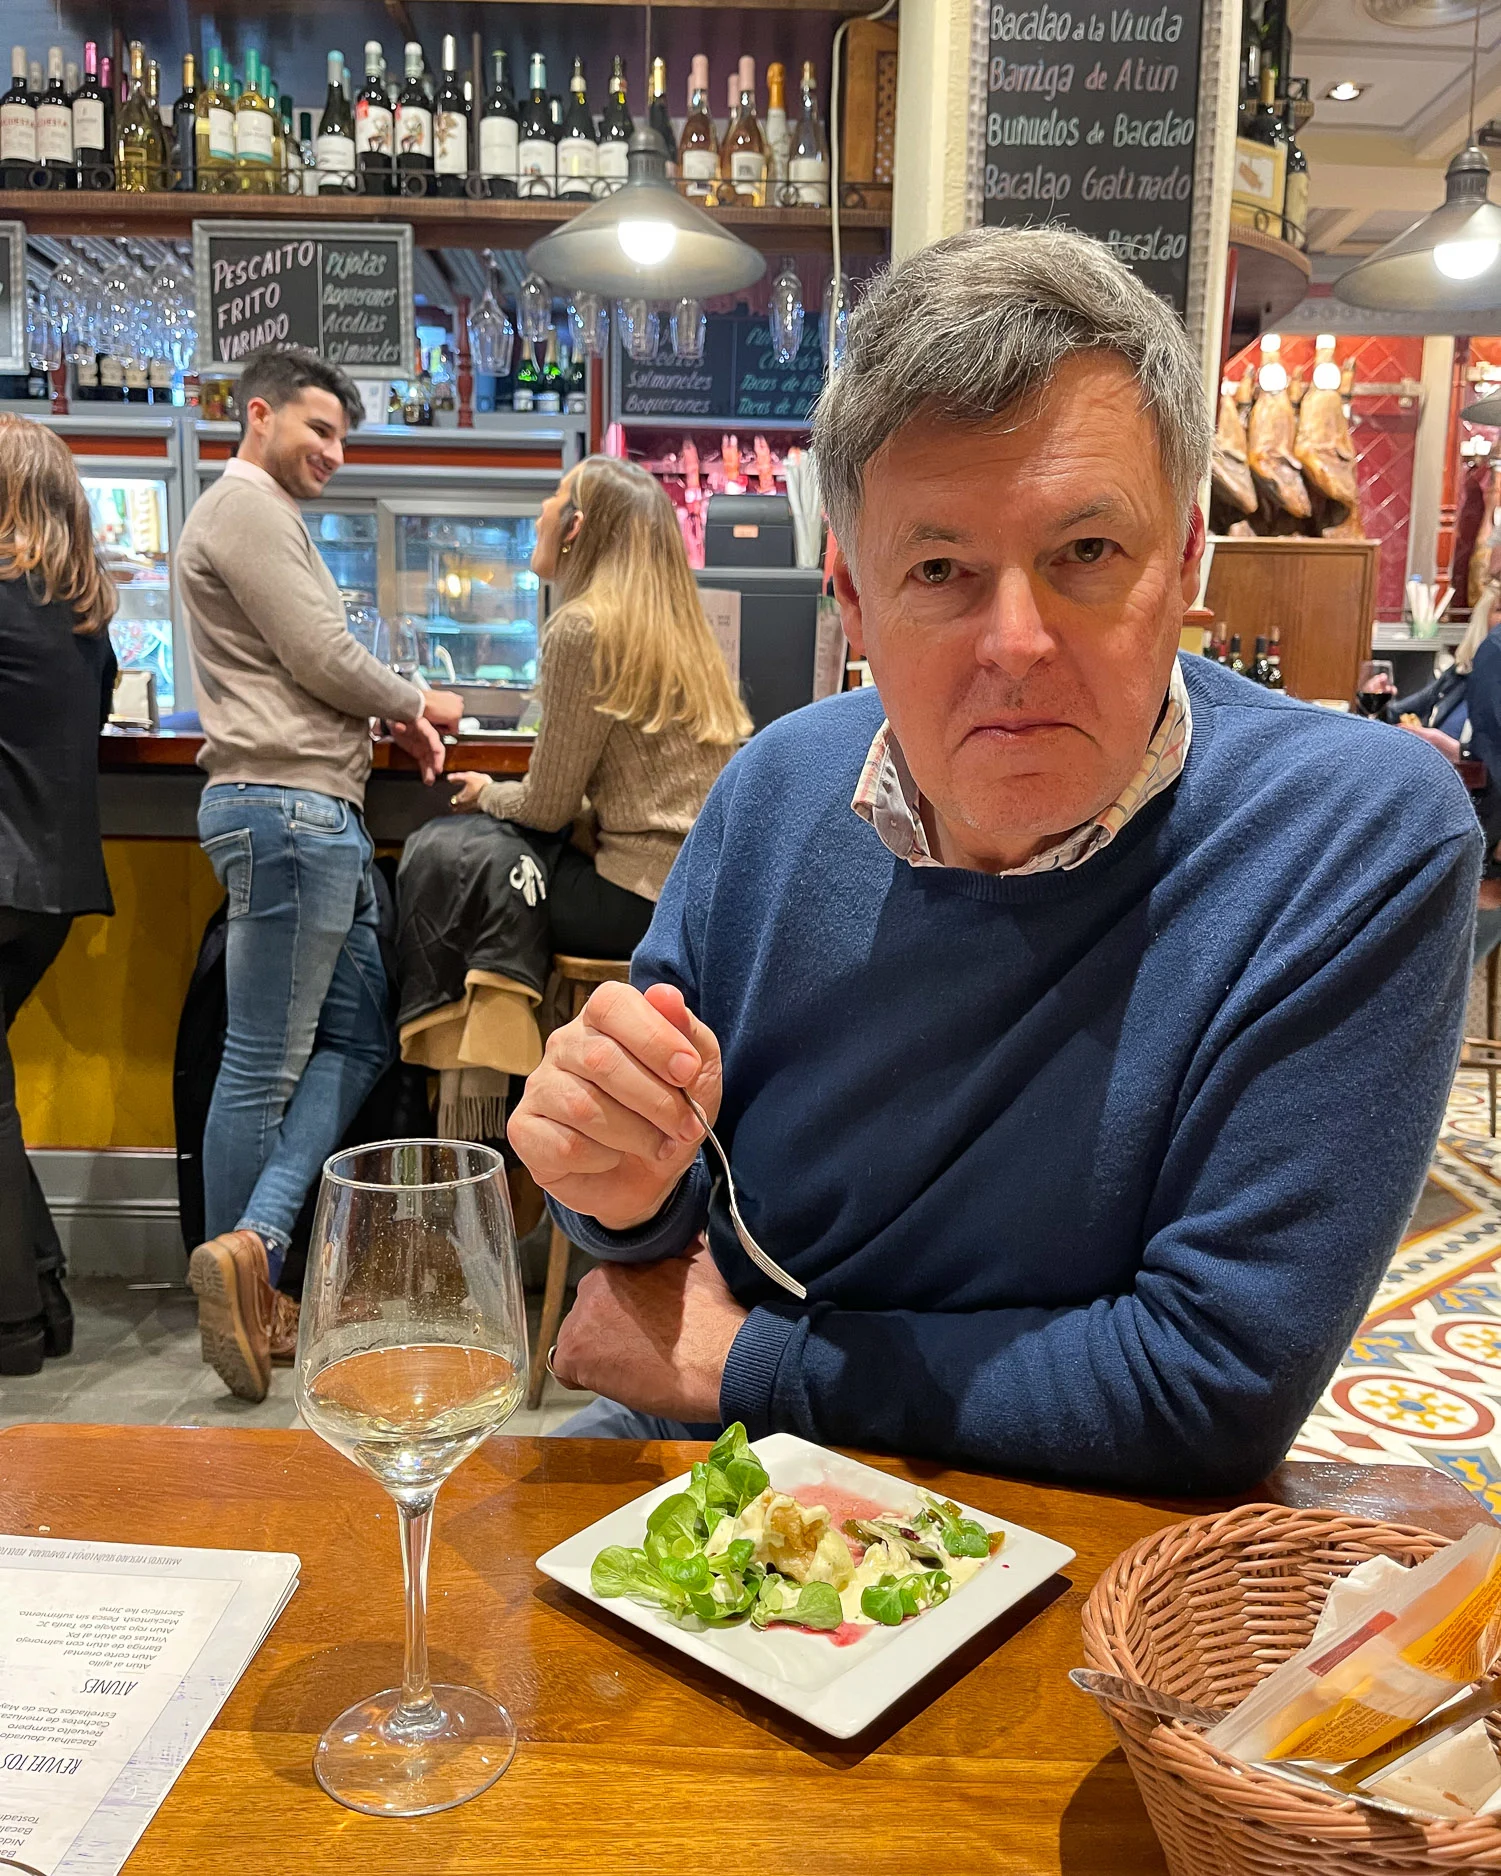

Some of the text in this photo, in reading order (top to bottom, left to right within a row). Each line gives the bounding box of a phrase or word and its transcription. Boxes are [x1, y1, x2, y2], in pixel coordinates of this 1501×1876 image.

[990, 3, 1183, 42] Bacalao a la Viuda
[989, 56, 1075, 101] Barriga
[1084, 61, 1107, 91] de
[1085, 121, 1105, 146] de
[1113, 109, 1195, 148] Bacalao
[984, 164, 1191, 201] Bacalao Gratinado
[1107, 226, 1187, 261] Bacalao
[213, 240, 315, 294] PESCAITO
[217, 282, 280, 330] FRITO
[219, 313, 289, 363] VARIADO
[141, 1608, 185, 1617] Sacrificio
[92, 1615, 120, 1623] Pesca
[51, 1621, 76, 1629] Tarifa
[94, 1623, 127, 1631] salvaje
[16, 1637, 64, 1645] salmorejo
[63, 1649, 102, 1657] oriental
[126, 1644, 162, 1652] Barriga
[80, 1678, 139, 1696] ATUNES
[0, 1702, 20, 1711] May
[37, 1706, 58, 1714] Dos
[59, 1708, 116, 1719] Estrellados
[62, 1718, 110, 1728] Cachetes
[7, 1723, 104, 1737] Revuelto campero
[47, 1736, 97, 1747] Bacalhau
[0, 1753, 83, 1775] REVUELTOS
